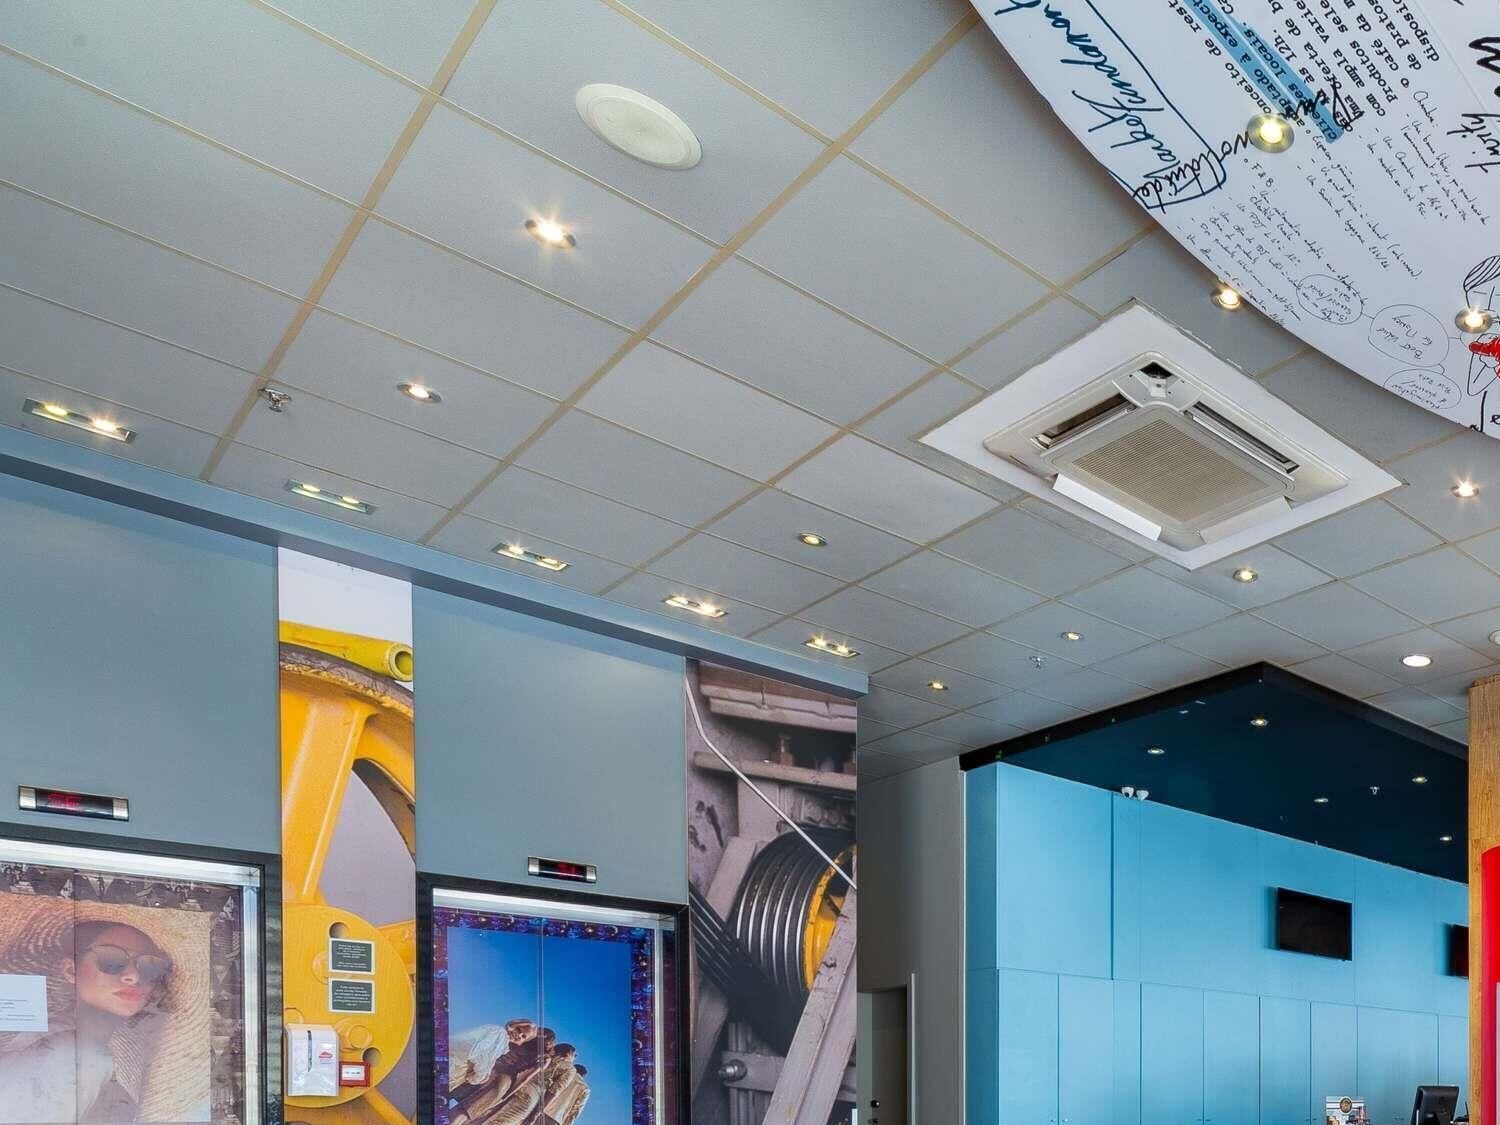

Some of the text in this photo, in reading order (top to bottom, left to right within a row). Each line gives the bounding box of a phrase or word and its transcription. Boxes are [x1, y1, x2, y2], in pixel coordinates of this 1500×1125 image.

[1285, 18, 1301, 37] de
[1356, 13, 1372, 33] da
[1392, 0, 1440, 62] disposi
[1204, 38, 1222, 57] de
[1243, 22, 1287, 78] locais.
[1273, 29, 1297, 62] 12h.
[1370, 38, 1399, 71] café
[1407, 52, 1422, 70] de
[1299, 67, 1315, 84] às
[1303, 42, 1342, 90] oferta
[1333, 48, 1365, 89] ampla
[1350, 40, 1398, 104] Produtos
[1225, 62, 1273, 115] onceito
[1254, 69, 1306, 127] adptado
[1365, 93, 1386, 117] com
